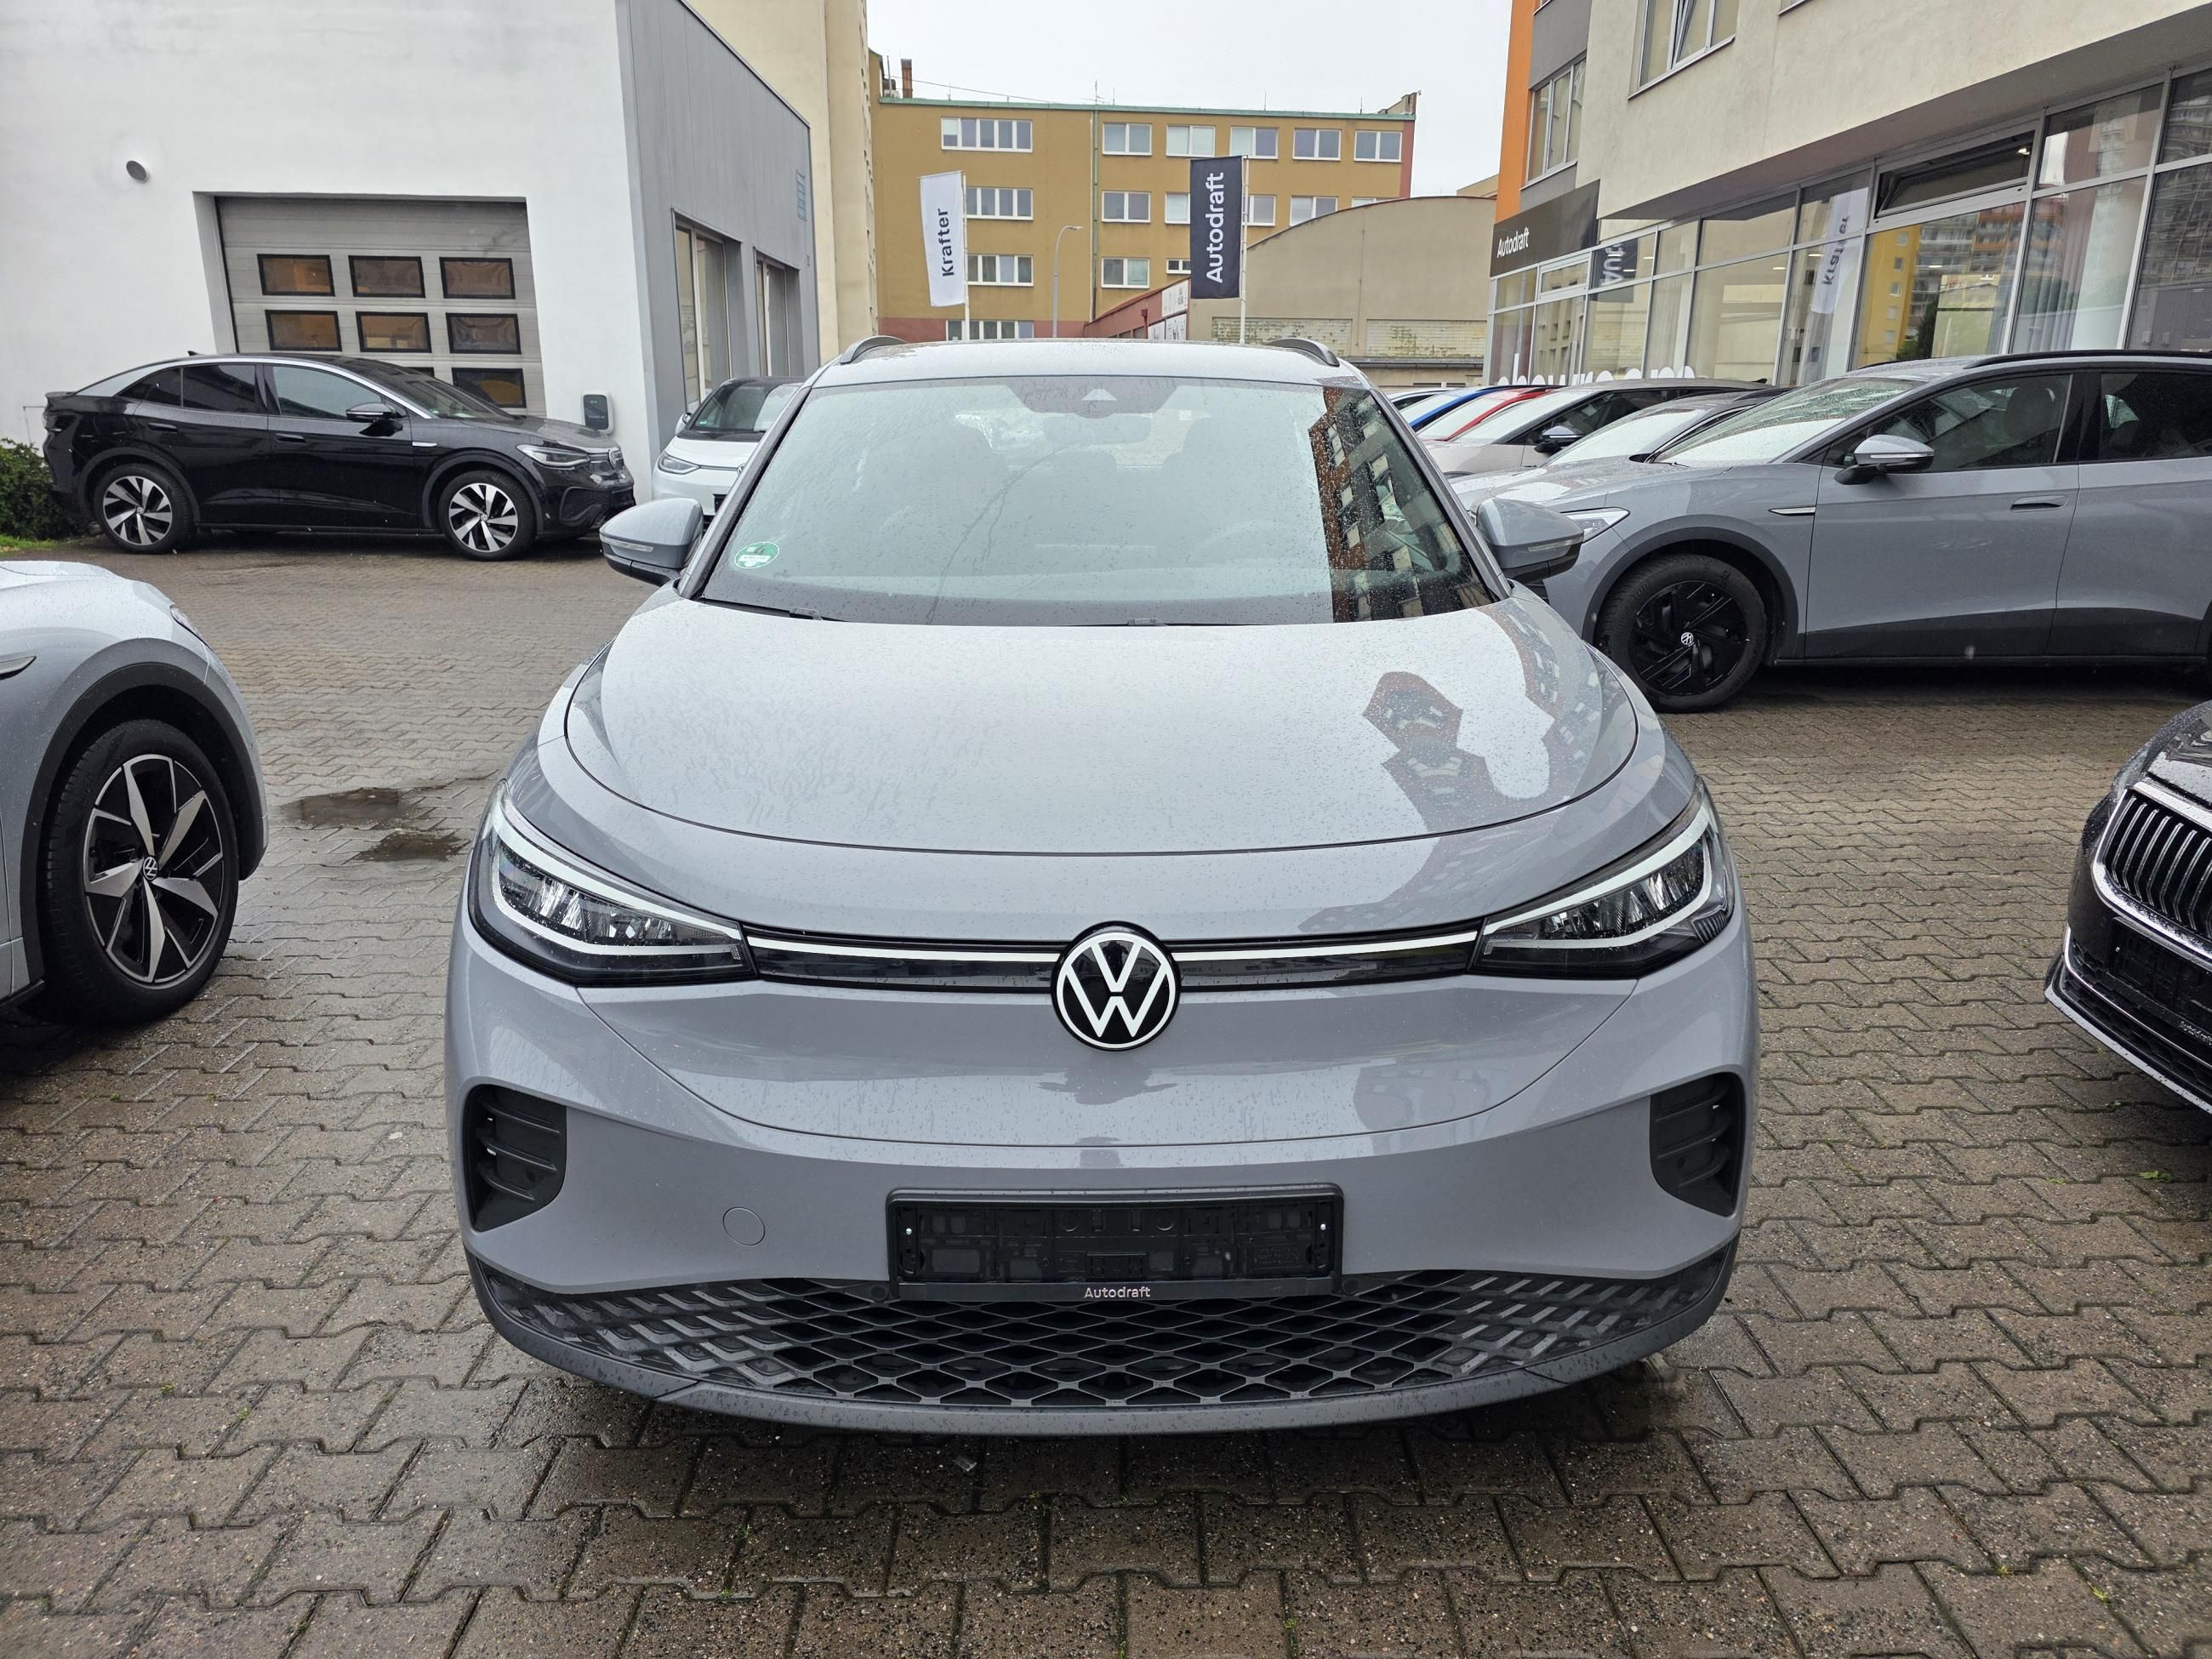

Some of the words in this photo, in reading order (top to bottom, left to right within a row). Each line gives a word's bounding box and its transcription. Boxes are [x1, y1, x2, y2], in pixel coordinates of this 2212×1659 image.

[938, 208, 955, 276] Krafter
[1205, 172, 1225, 284] Autodraft
[1497, 225, 1530, 259] Autodraft
[1058, 933, 1174, 1046] VW
[1084, 1286, 1151, 1298] Autodraft
